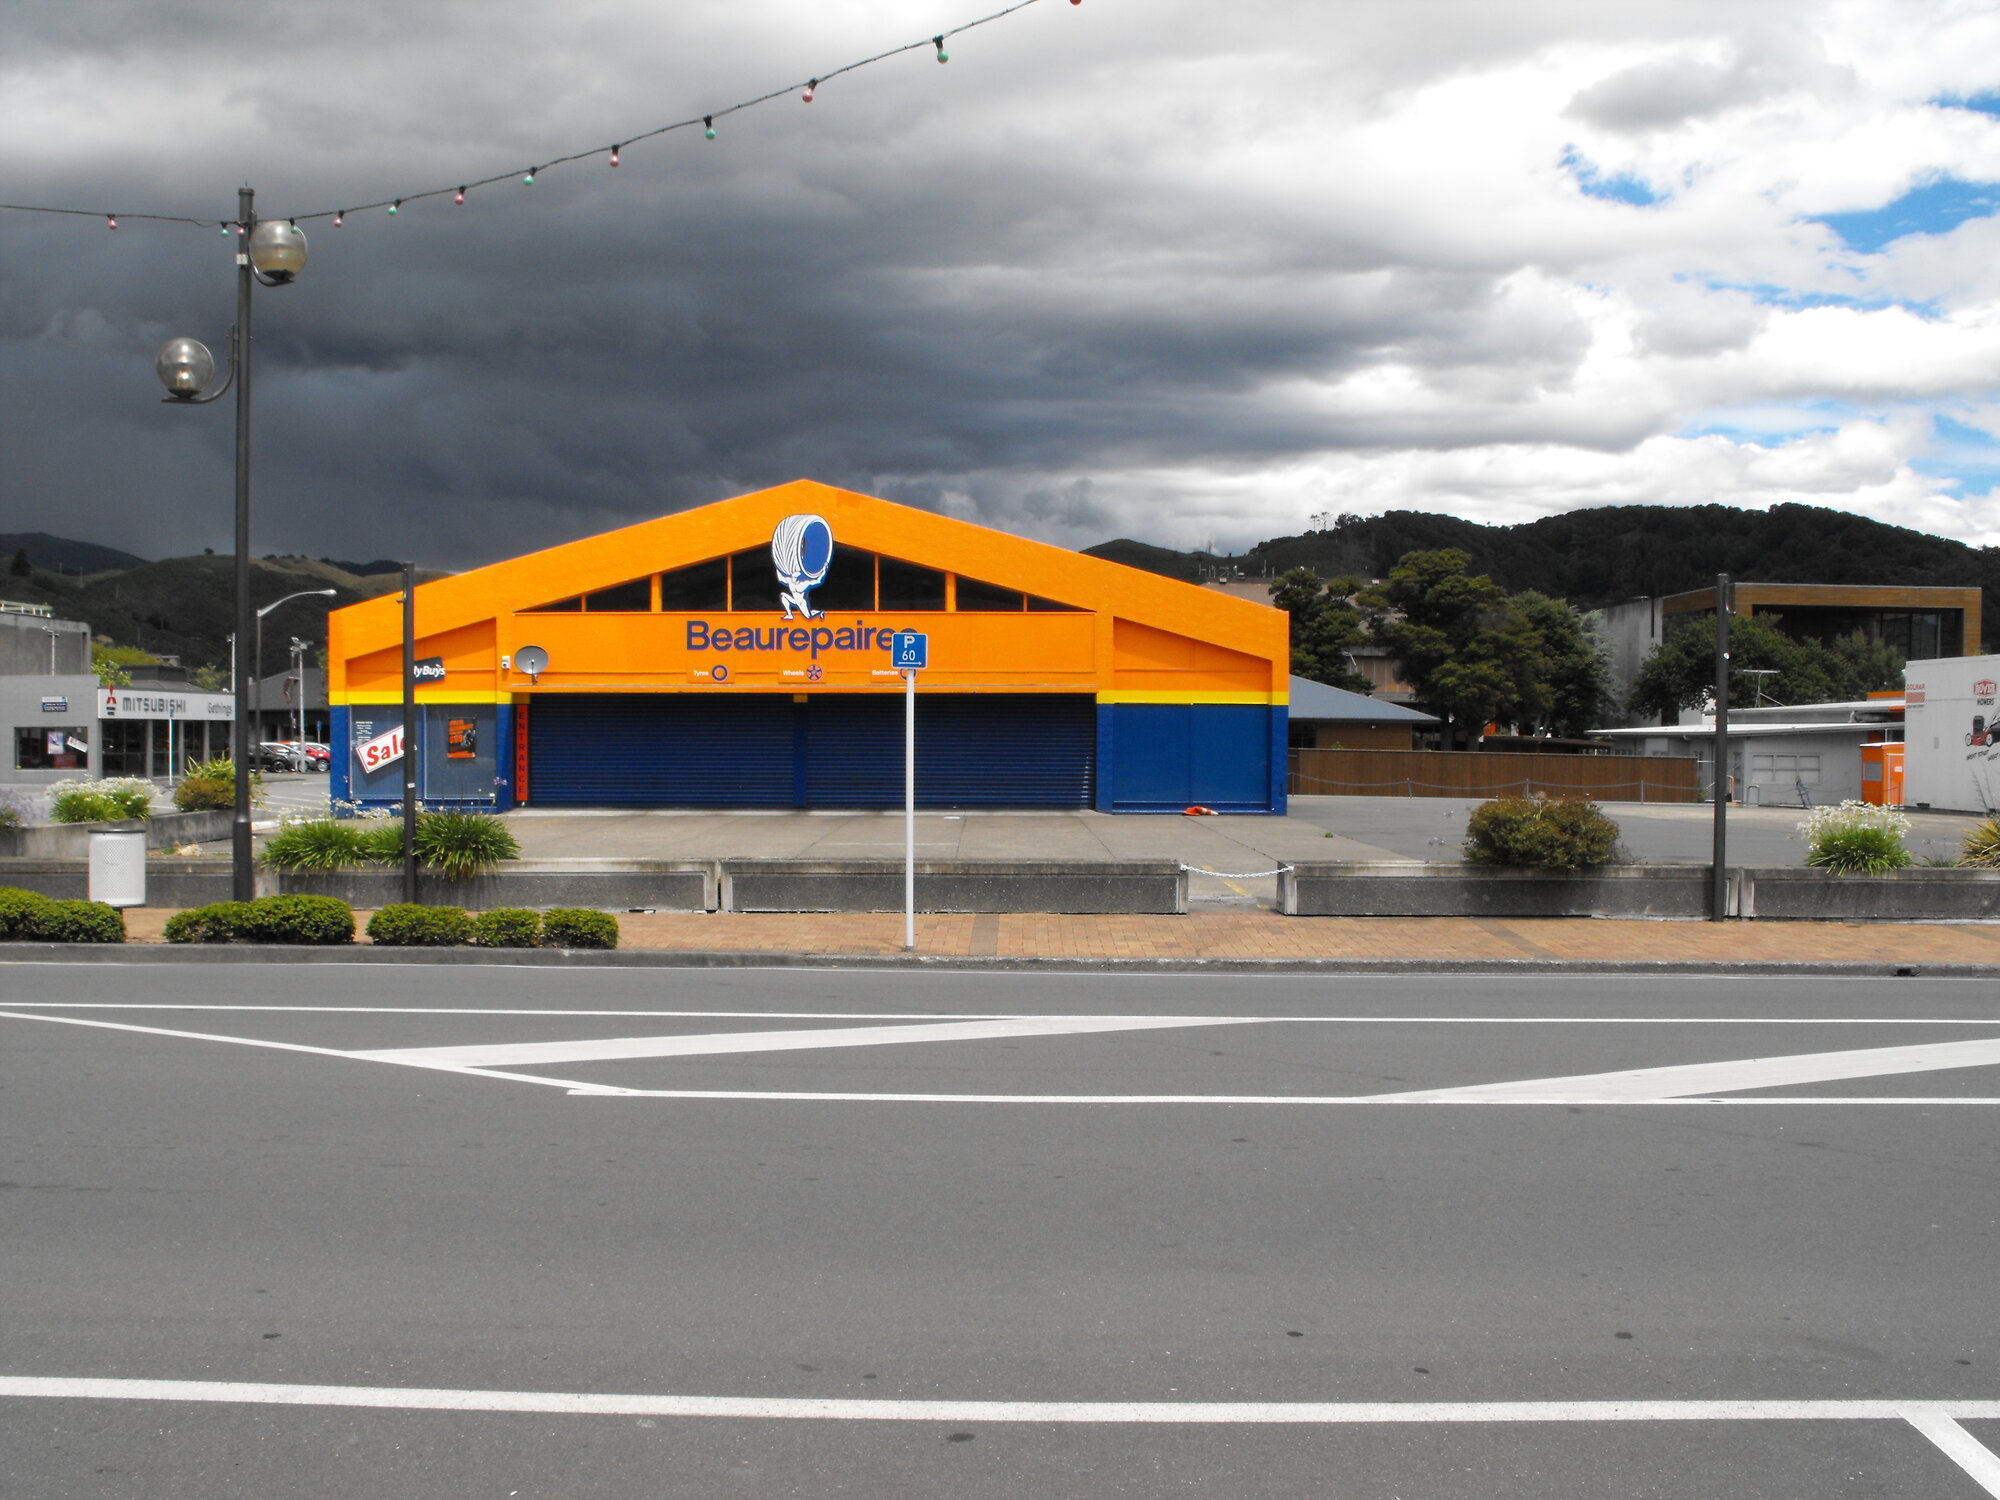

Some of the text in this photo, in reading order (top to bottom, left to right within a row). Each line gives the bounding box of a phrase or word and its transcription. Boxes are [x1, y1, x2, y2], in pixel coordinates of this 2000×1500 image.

[686, 620, 918, 660] Beaurepaire
[904, 635, 915, 648] P
[902, 650, 915, 661] 60
[413, 664, 446, 678] lyBuys
[123, 697, 186, 712] MITSUBISHI
[518, 711, 526, 794] ENTRANCE
